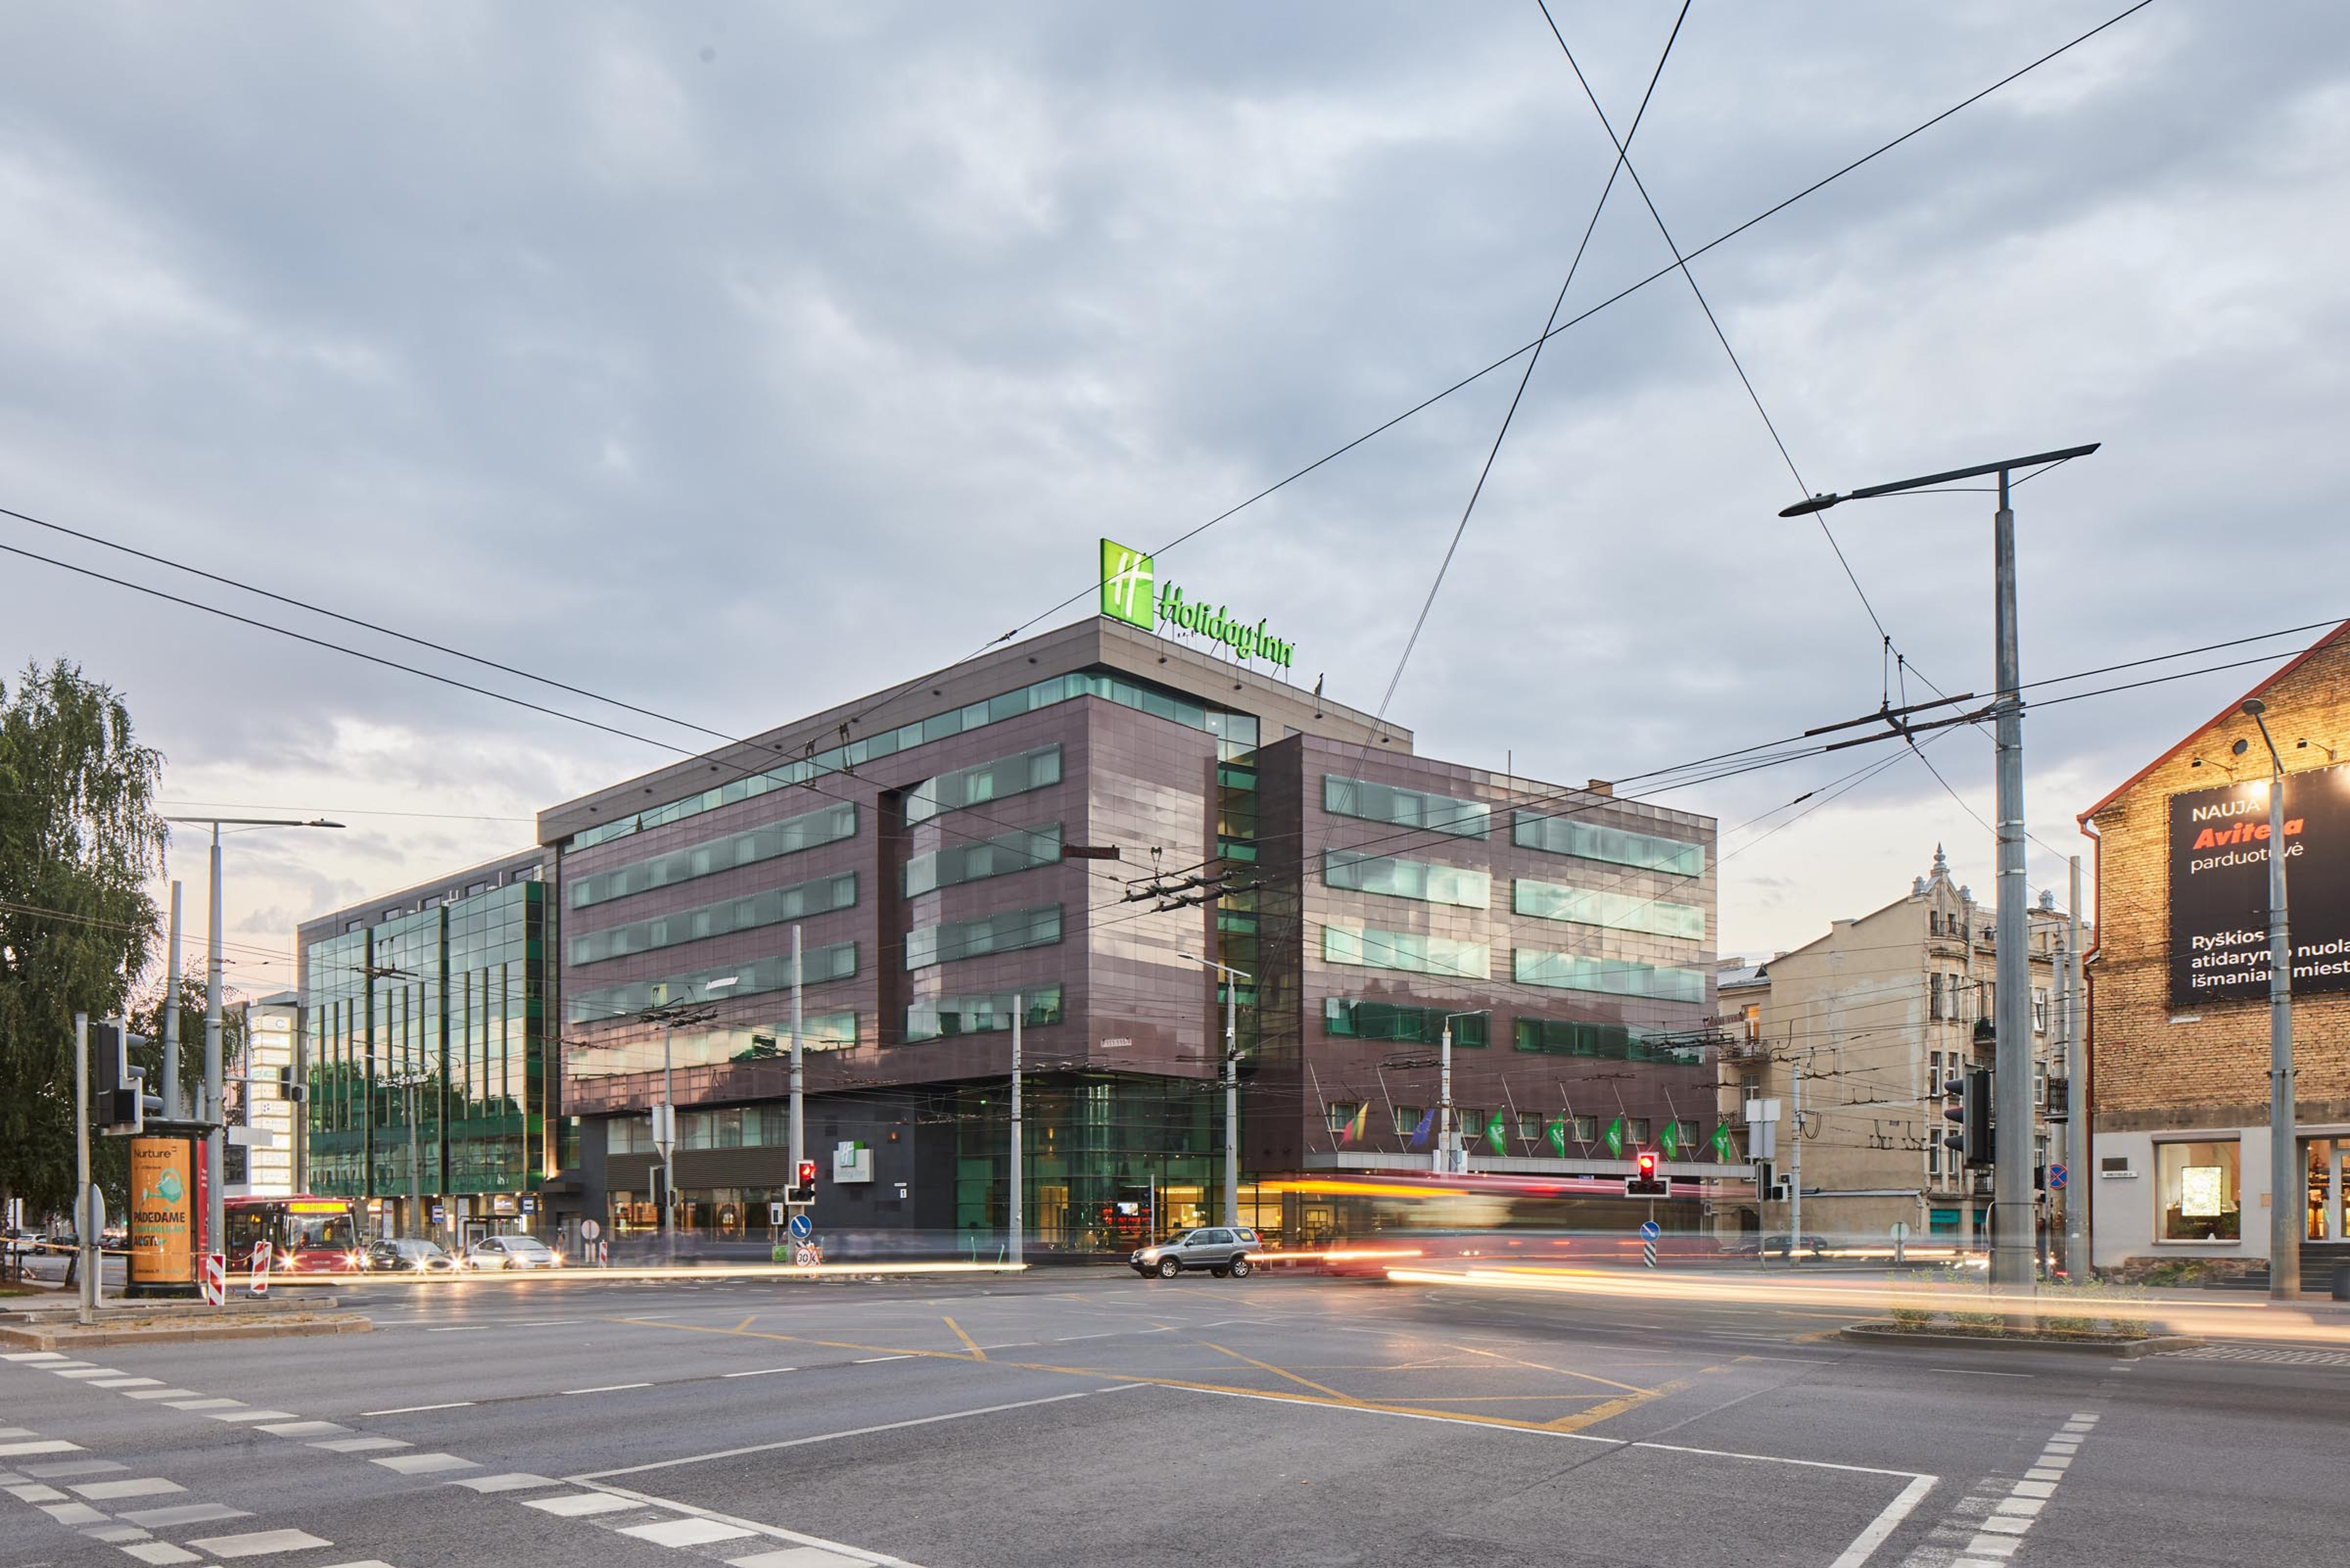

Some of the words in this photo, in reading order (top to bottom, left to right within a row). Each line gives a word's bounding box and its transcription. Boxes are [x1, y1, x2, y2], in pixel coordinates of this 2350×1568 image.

[1158, 581, 1254, 659] Holiday
[1256, 618, 1293, 668] Inn
[2193, 799, 2261, 821] NAUJA
[2193, 818, 2303, 849] Avitea
[2191, 842, 2303, 874] parduotvė
[2192, 930, 2264, 950] Ryškios
[2192, 968, 2272, 988] išmania
[134, 1149, 171, 1158] Nurture
[133, 1212, 185, 1223] PADEDAME
[799, 1253, 808, 1262] 30
